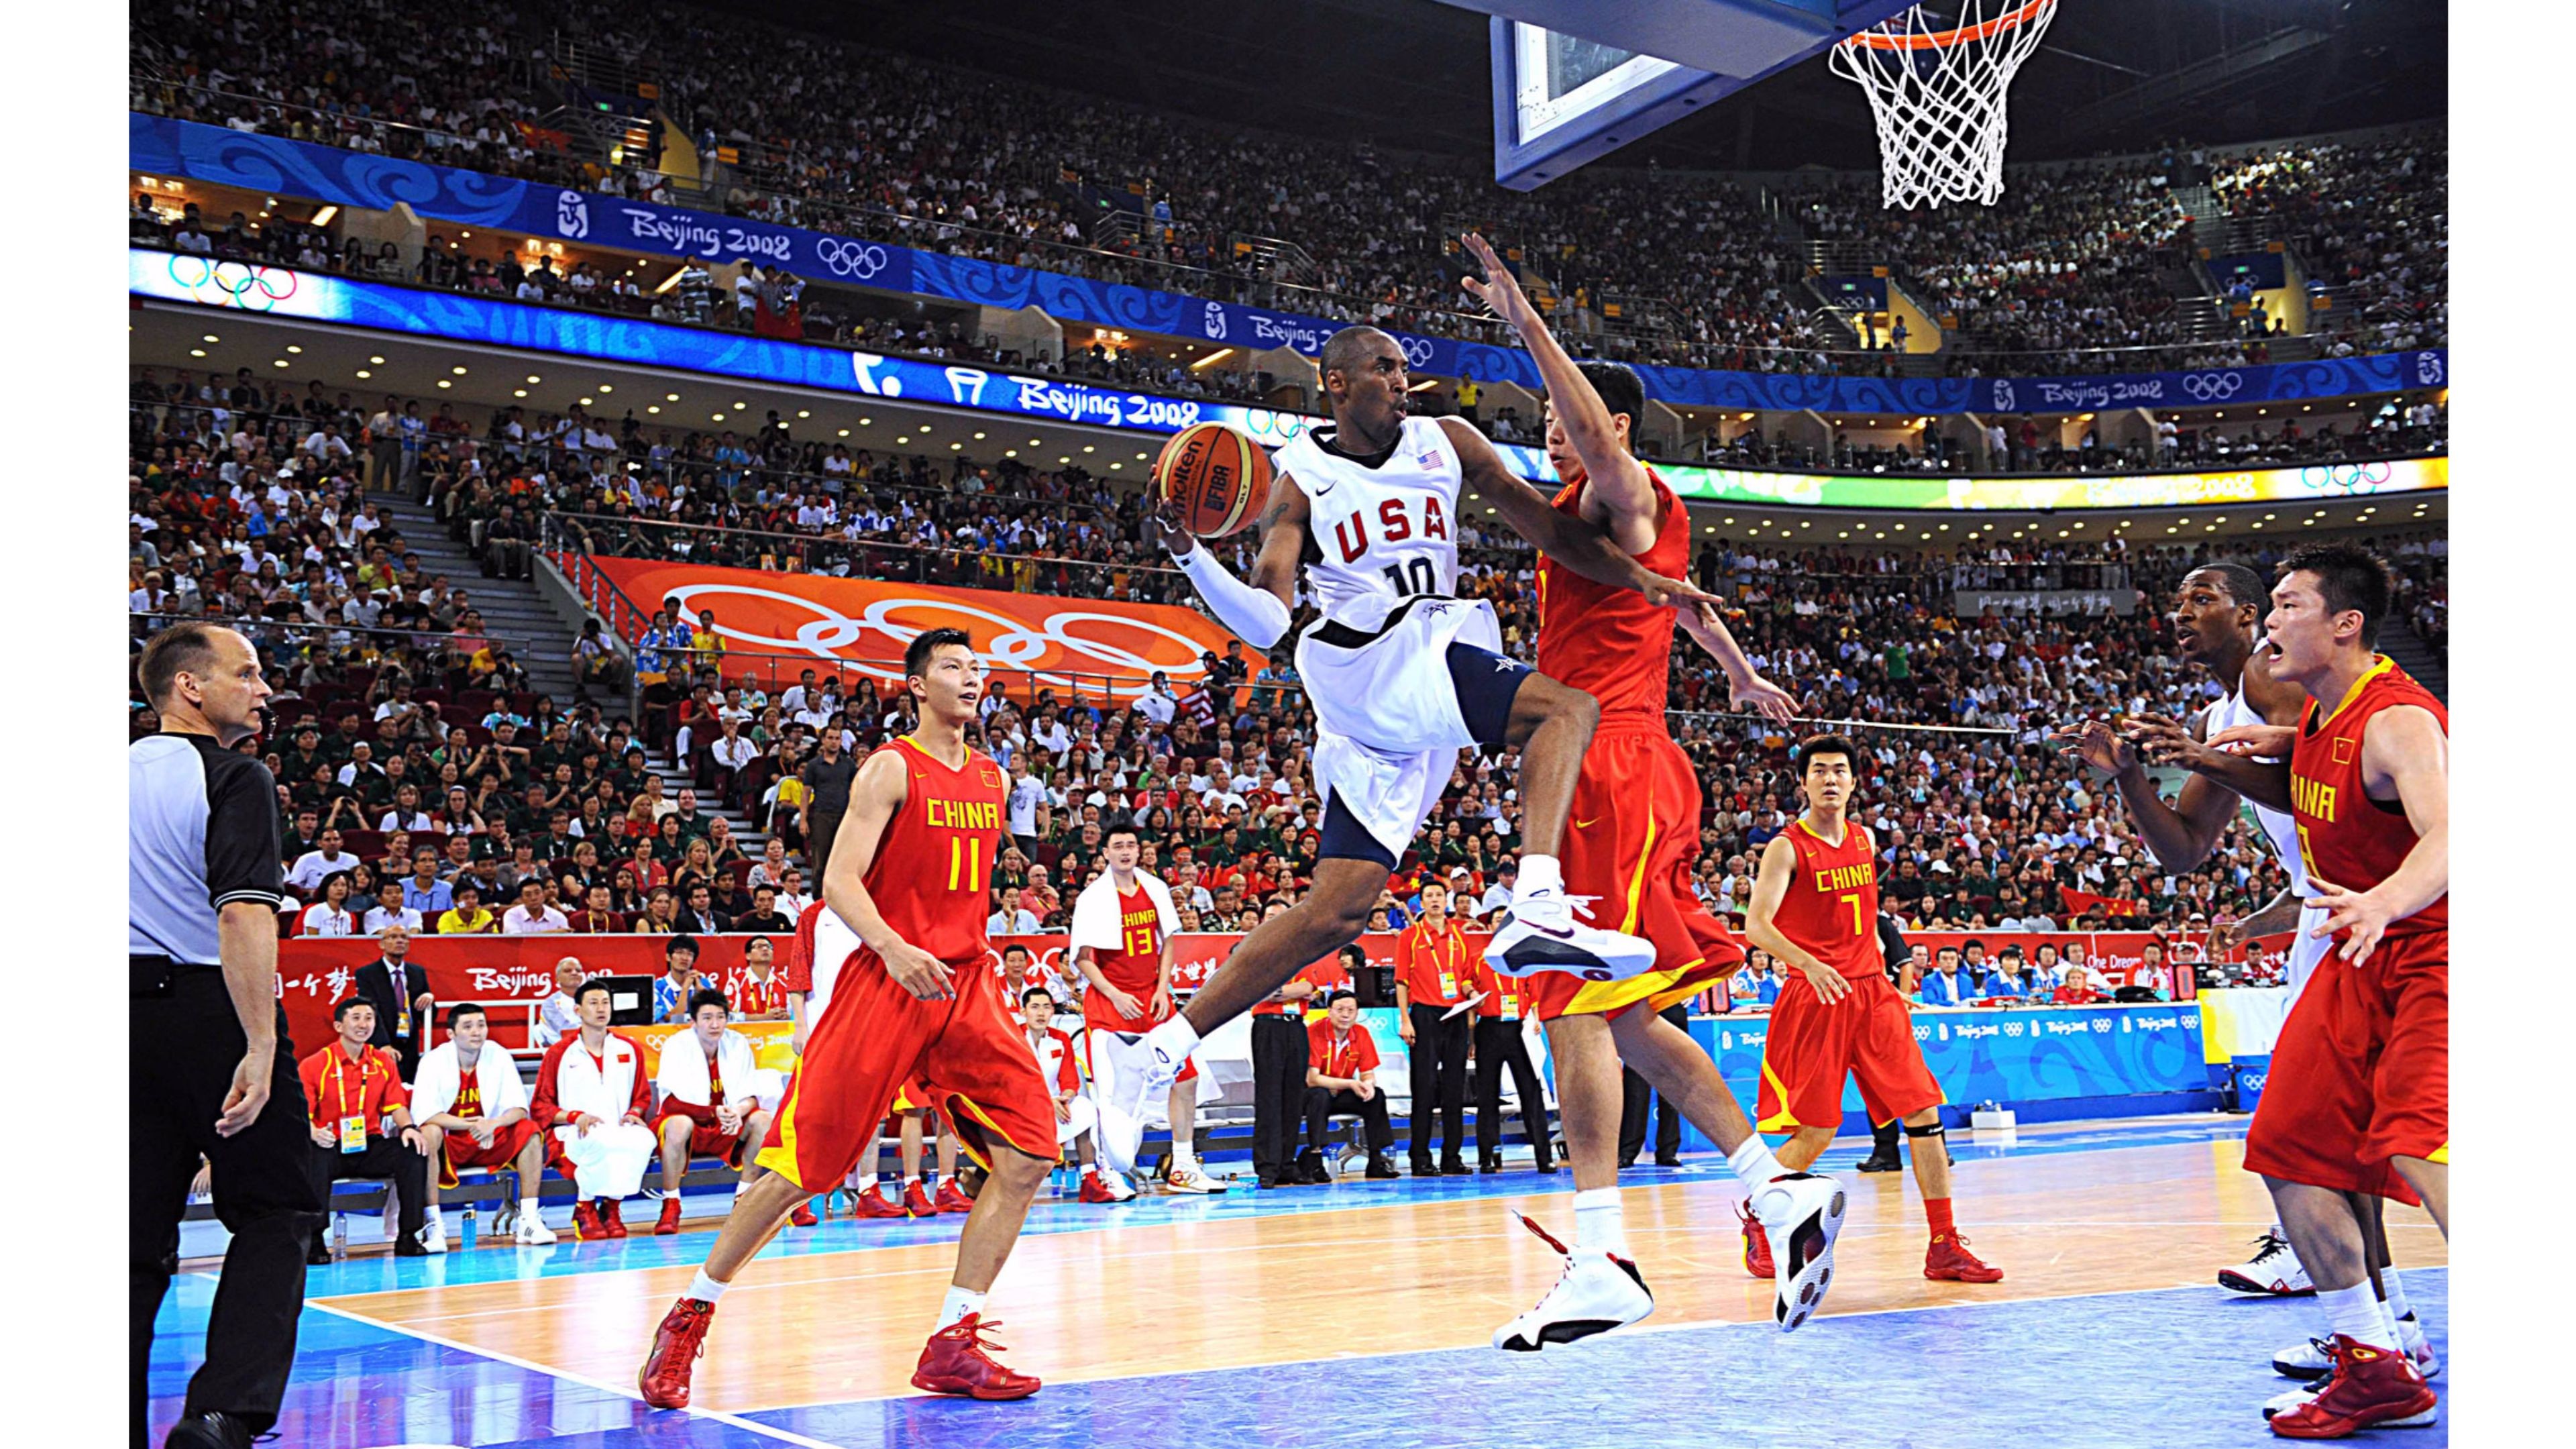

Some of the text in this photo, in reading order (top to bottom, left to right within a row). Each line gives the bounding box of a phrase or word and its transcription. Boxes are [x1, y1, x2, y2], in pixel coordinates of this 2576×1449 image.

[621, 209, 792, 261] Beijing 2008
[1248, 315, 1318, 352] Beijing
[1008, 376, 1201, 429] Beijing 2008
[2037, 380, 2163, 407] Beijing 2008
[1174, 440, 1203, 515] molten
[1207, 464, 1230, 503] FIBA
[2180, 473, 2257, 500] 2008
[1335, 496, 1446, 564] USA
[1381, 556, 1435, 598] 10
[926, 798, 1000, 830] CHINA
[2291, 771, 2337, 823] HINA
[948, 836, 979, 892] 11
[1815, 863, 1873, 893] CHINA
[1841, 894, 1862, 936] 7
[1125, 928, 1152, 957] 13
[2087, 955, 2143, 969] One Dream
[465, 966, 551, 997] Beijing
